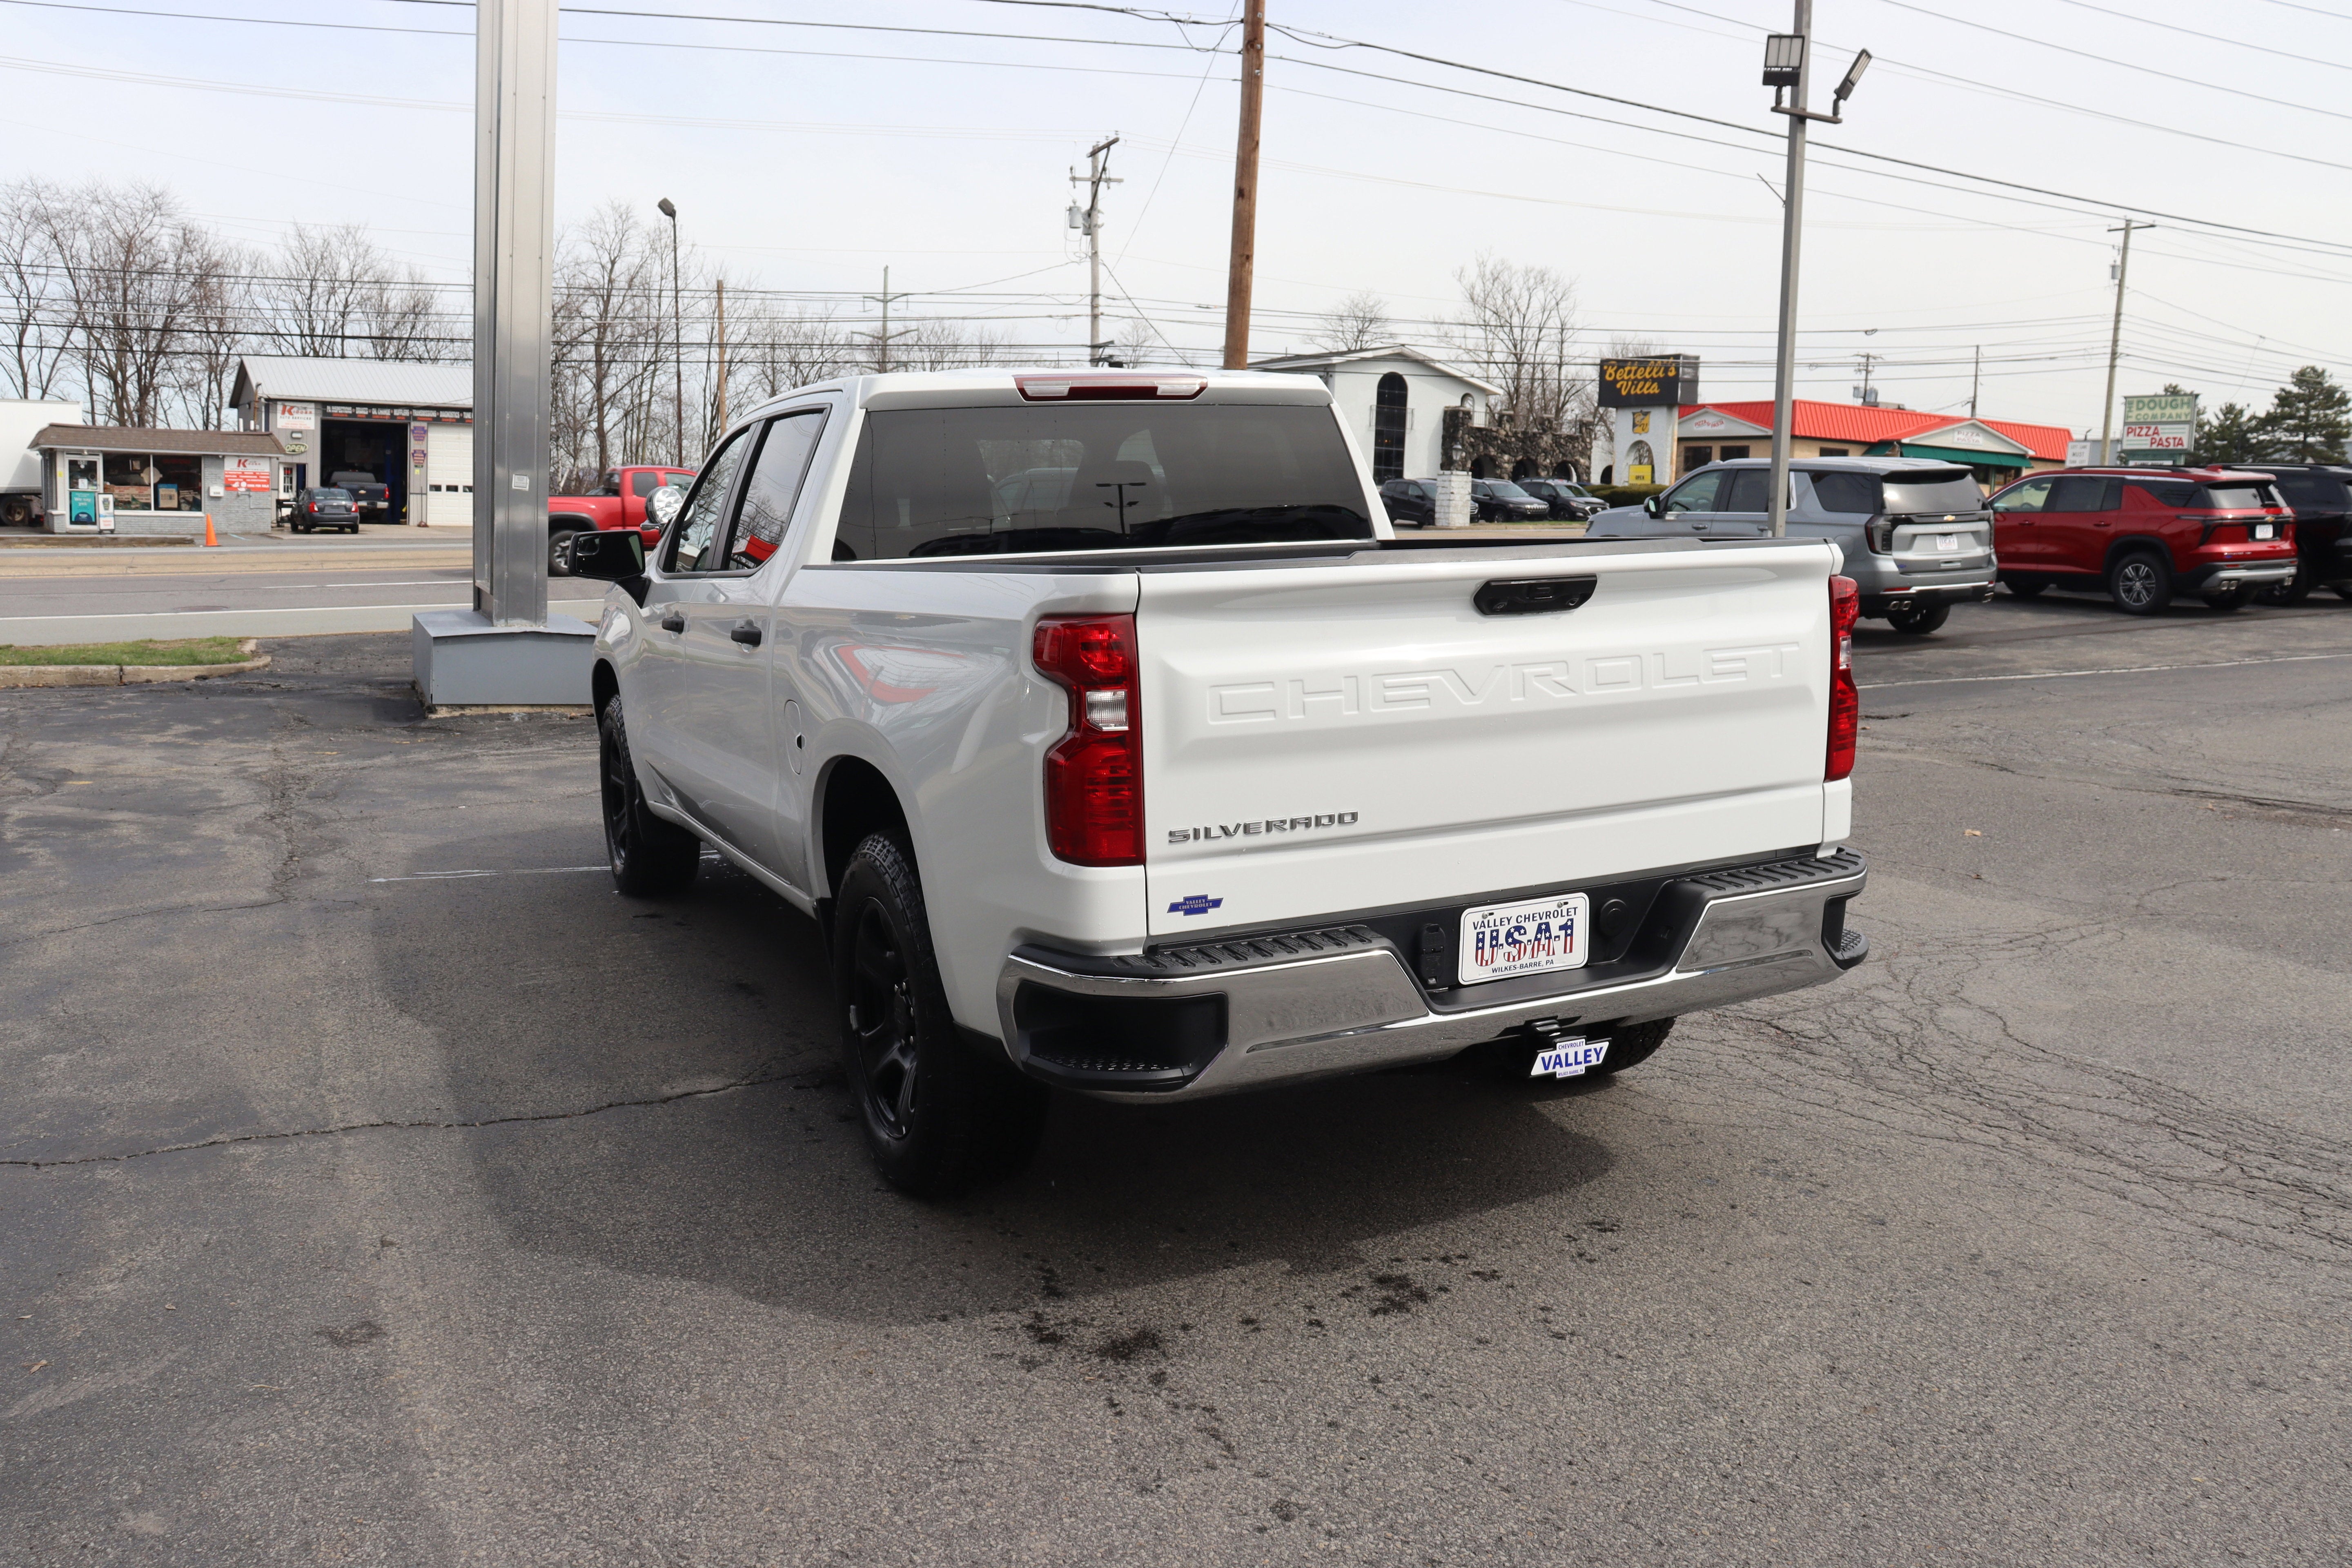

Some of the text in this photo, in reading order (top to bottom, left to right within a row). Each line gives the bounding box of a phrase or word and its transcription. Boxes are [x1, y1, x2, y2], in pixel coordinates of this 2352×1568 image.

[1604, 357, 1677, 381] Bettelli's
[1616, 379, 1660, 396] Villa
[2136, 398, 2191, 410] DOUGH
[2135, 412, 2191, 421] COMPANY
[2126, 425, 2160, 437] PIZZA
[2149, 437, 2185, 448] PASTA
[1207, 641, 1800, 725] CHEVROLET
[1168, 810, 1358, 844] SILVERADO
[1472, 906, 1578, 930] VALLEY CHEVROLET
[1492, 961, 1544, 973] WILKES-BARRE,
[1558, 1041, 1584, 1050] CHEVROLET
[1541, 1046, 1604, 1071] VALLEY
